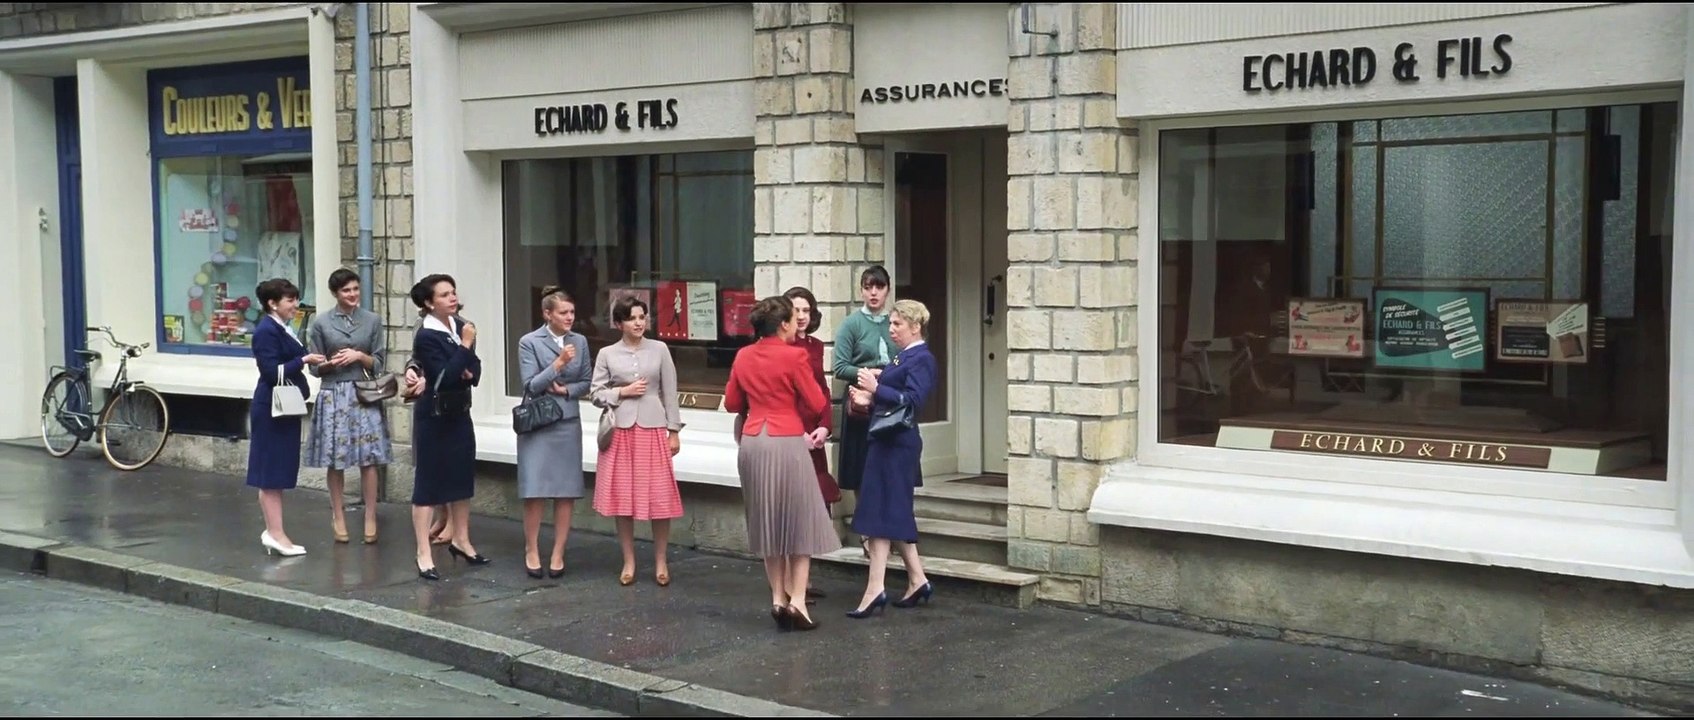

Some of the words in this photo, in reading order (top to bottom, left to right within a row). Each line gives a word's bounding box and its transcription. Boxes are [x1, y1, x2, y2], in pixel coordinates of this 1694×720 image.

[1243, 47, 1377, 92] ECHARD
[1392, 42, 1420, 82] &
[1437, 34, 1513, 79] FILS
[163, 86, 250, 135] COULEURS
[257, 91, 273, 130] &
[535, 103, 608, 134] ECHARD
[615, 102, 631, 130] &
[637, 98, 679, 129] FILS
[1382, 320, 1414, 329] ECHARD
[1425, 321, 1442, 330] FILS
[1300, 433, 1405, 454] ECHARD
[1418, 442, 1435, 457] &
[1450, 443, 1507, 462] FILS
